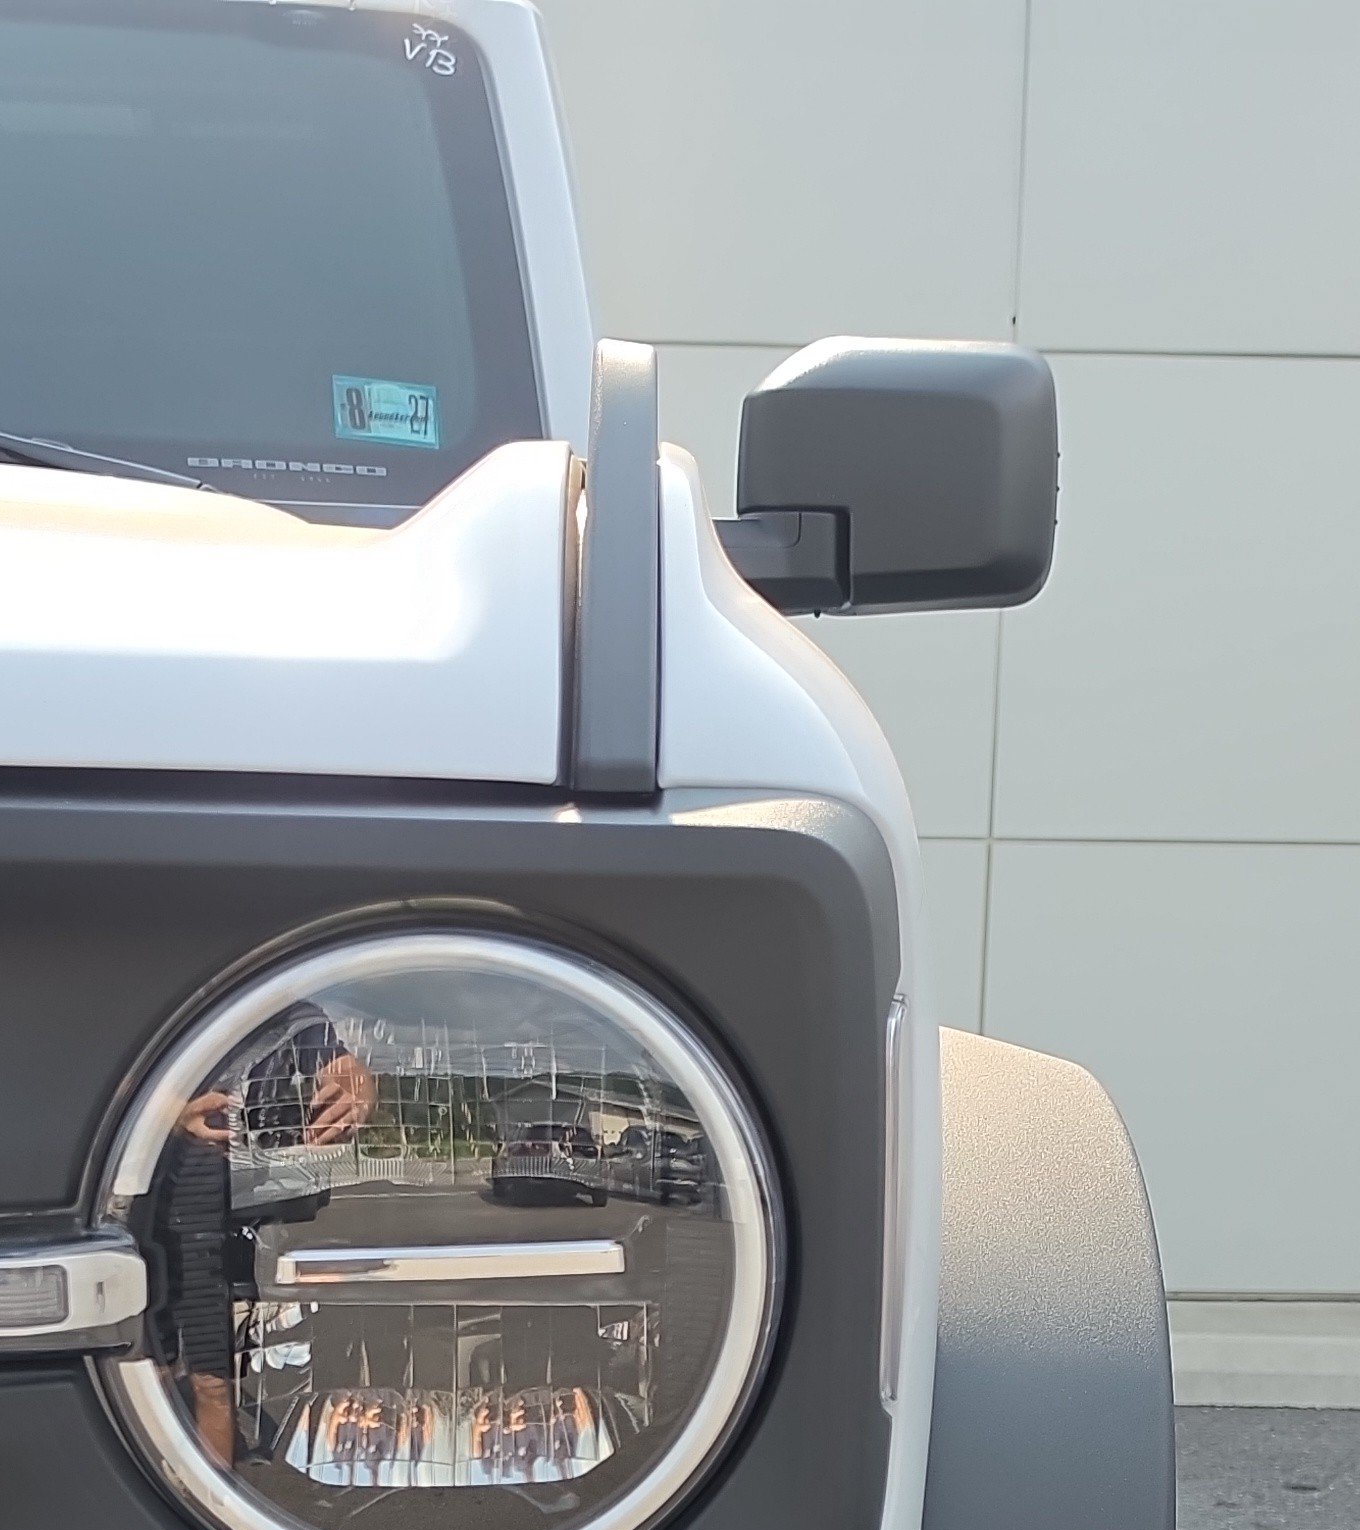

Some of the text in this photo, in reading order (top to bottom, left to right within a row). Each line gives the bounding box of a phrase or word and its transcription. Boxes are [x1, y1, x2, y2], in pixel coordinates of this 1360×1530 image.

[346, 387, 430, 438] 8 27
[187, 457, 387, 476] BRONCO
